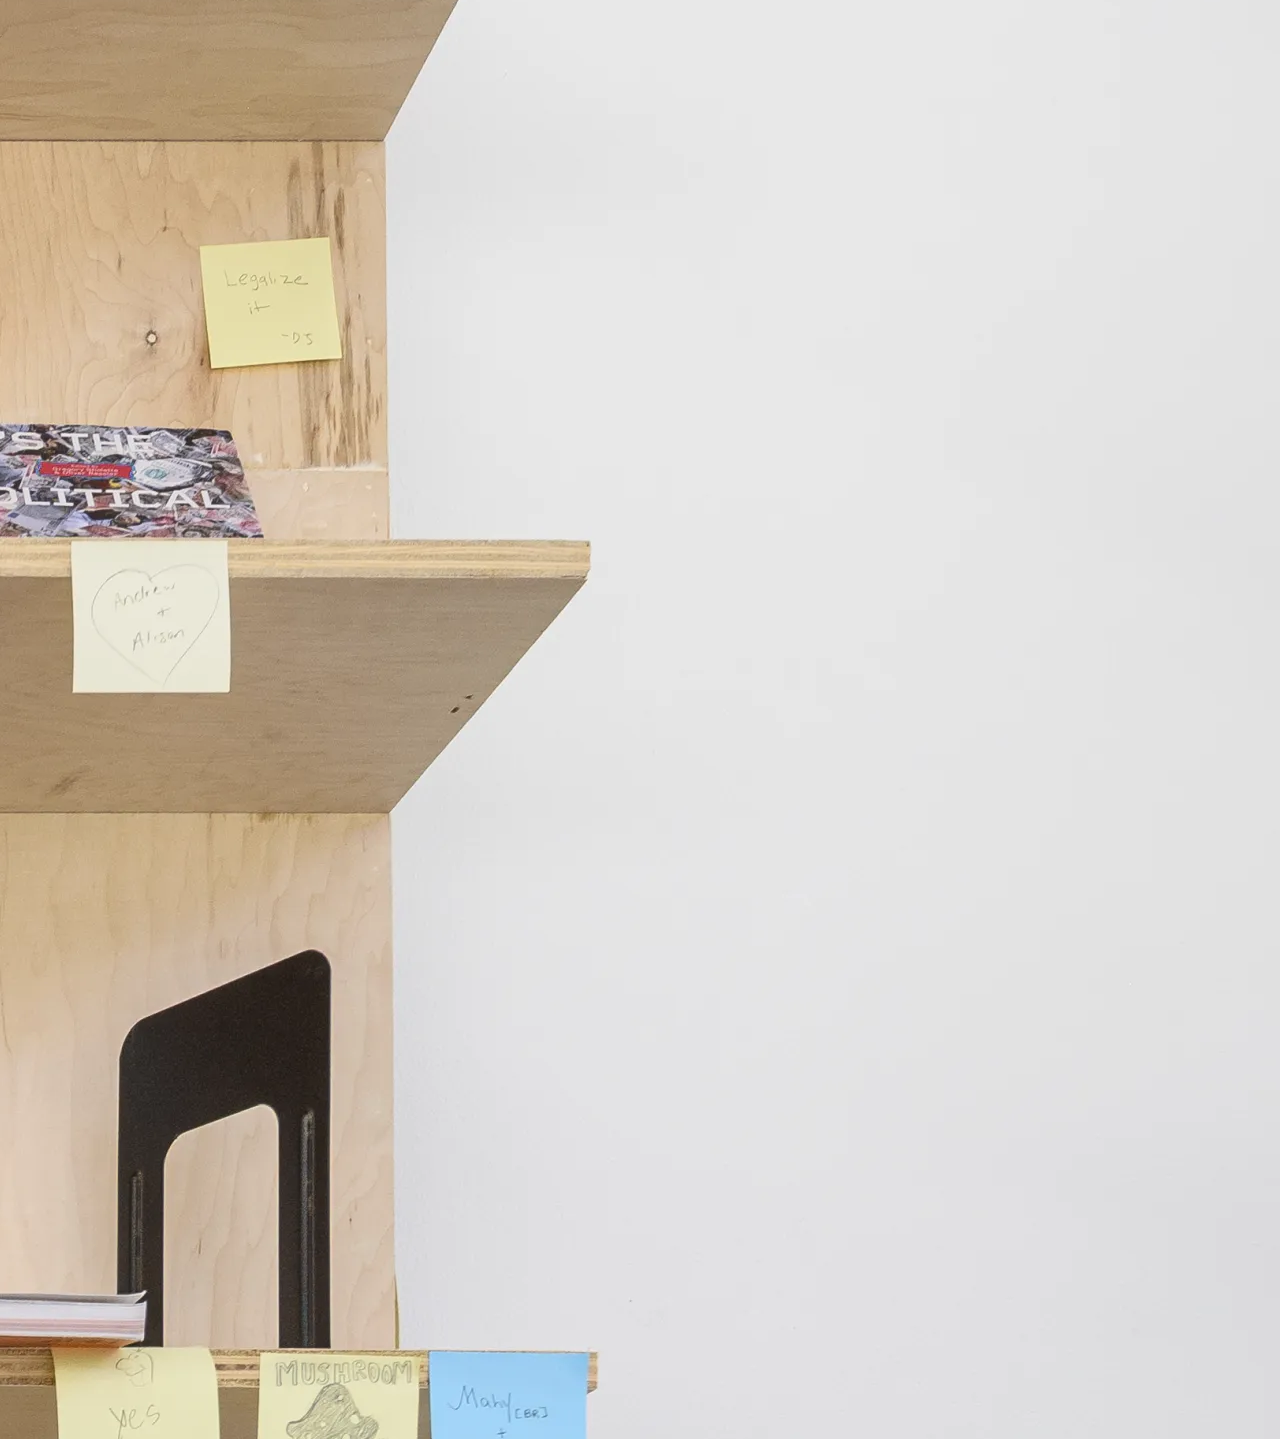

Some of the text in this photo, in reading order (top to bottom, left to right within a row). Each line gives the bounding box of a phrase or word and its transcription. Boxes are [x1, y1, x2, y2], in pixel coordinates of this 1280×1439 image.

[224, 270, 308, 290] Legalize
[248, 301, 270, 314] it
[62, 432, 157, 456] THE
[275, 1360, 412, 1387] MUSHROOM
